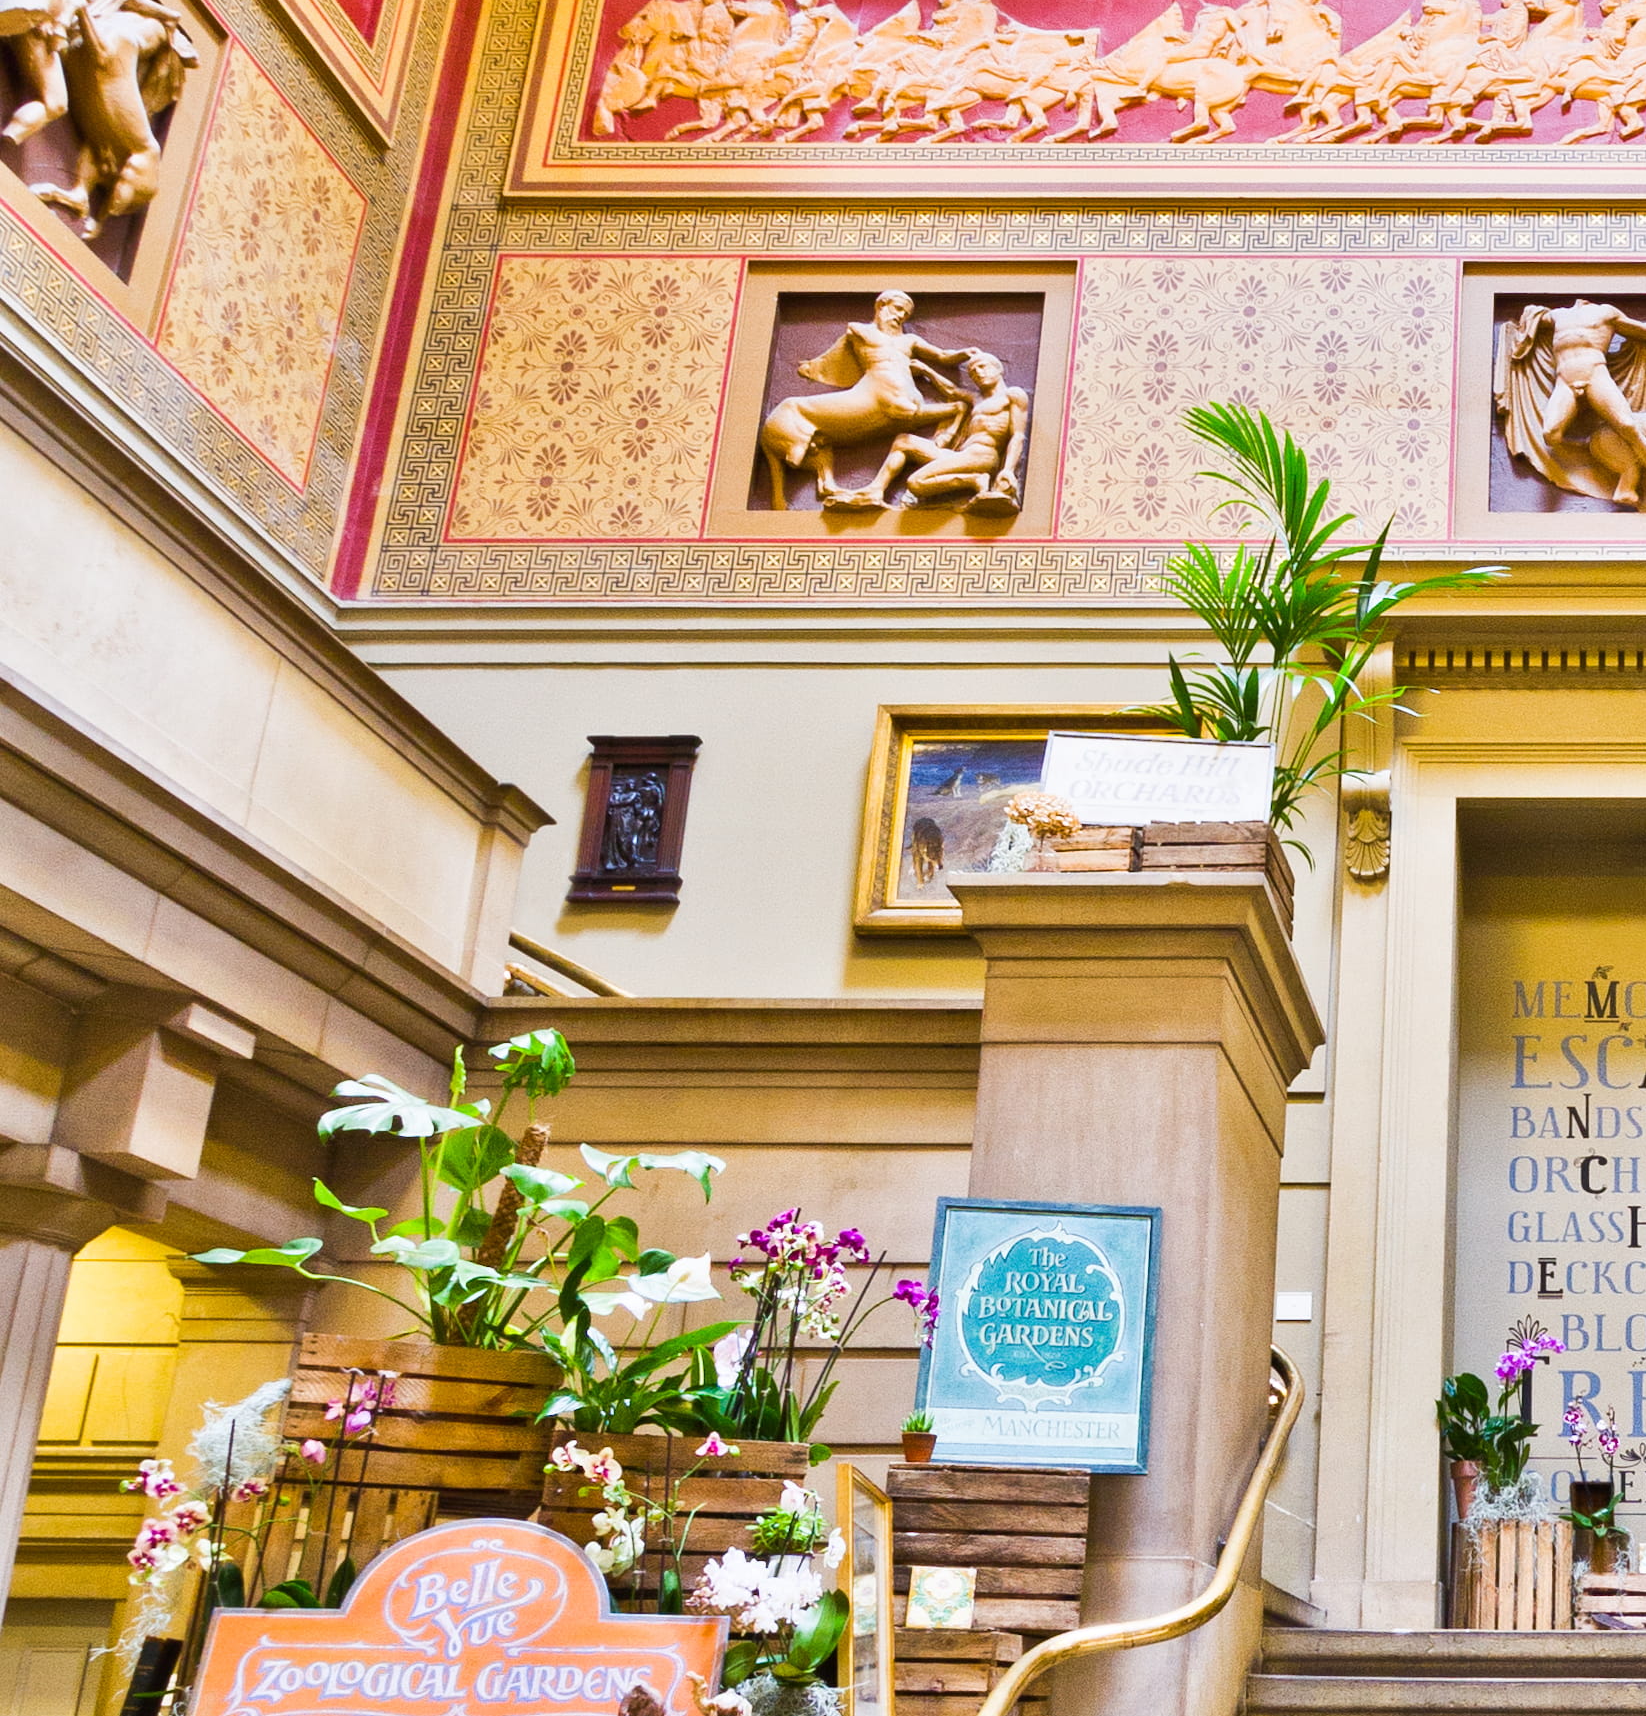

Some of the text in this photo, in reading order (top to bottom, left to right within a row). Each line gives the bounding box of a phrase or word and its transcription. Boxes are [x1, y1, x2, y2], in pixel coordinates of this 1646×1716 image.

[1075, 748, 1240, 777] Shude Hill
[1068, 779, 1241, 805] ORCHARDS
[1029, 1246, 1067, 1270] The
[1005, 1271, 1086, 1296] ROYAL
[978, 1295, 1114, 1323] BOTANICAL
[978, 1322, 1095, 1356] GARDENS
[982, 1415, 1121, 1440] MANCHESTER
[408, 1558, 520, 1619] Belle
[431, 1592, 540, 1659] Vue
[249, 1659, 468, 1702] ZOOLOGICAL
